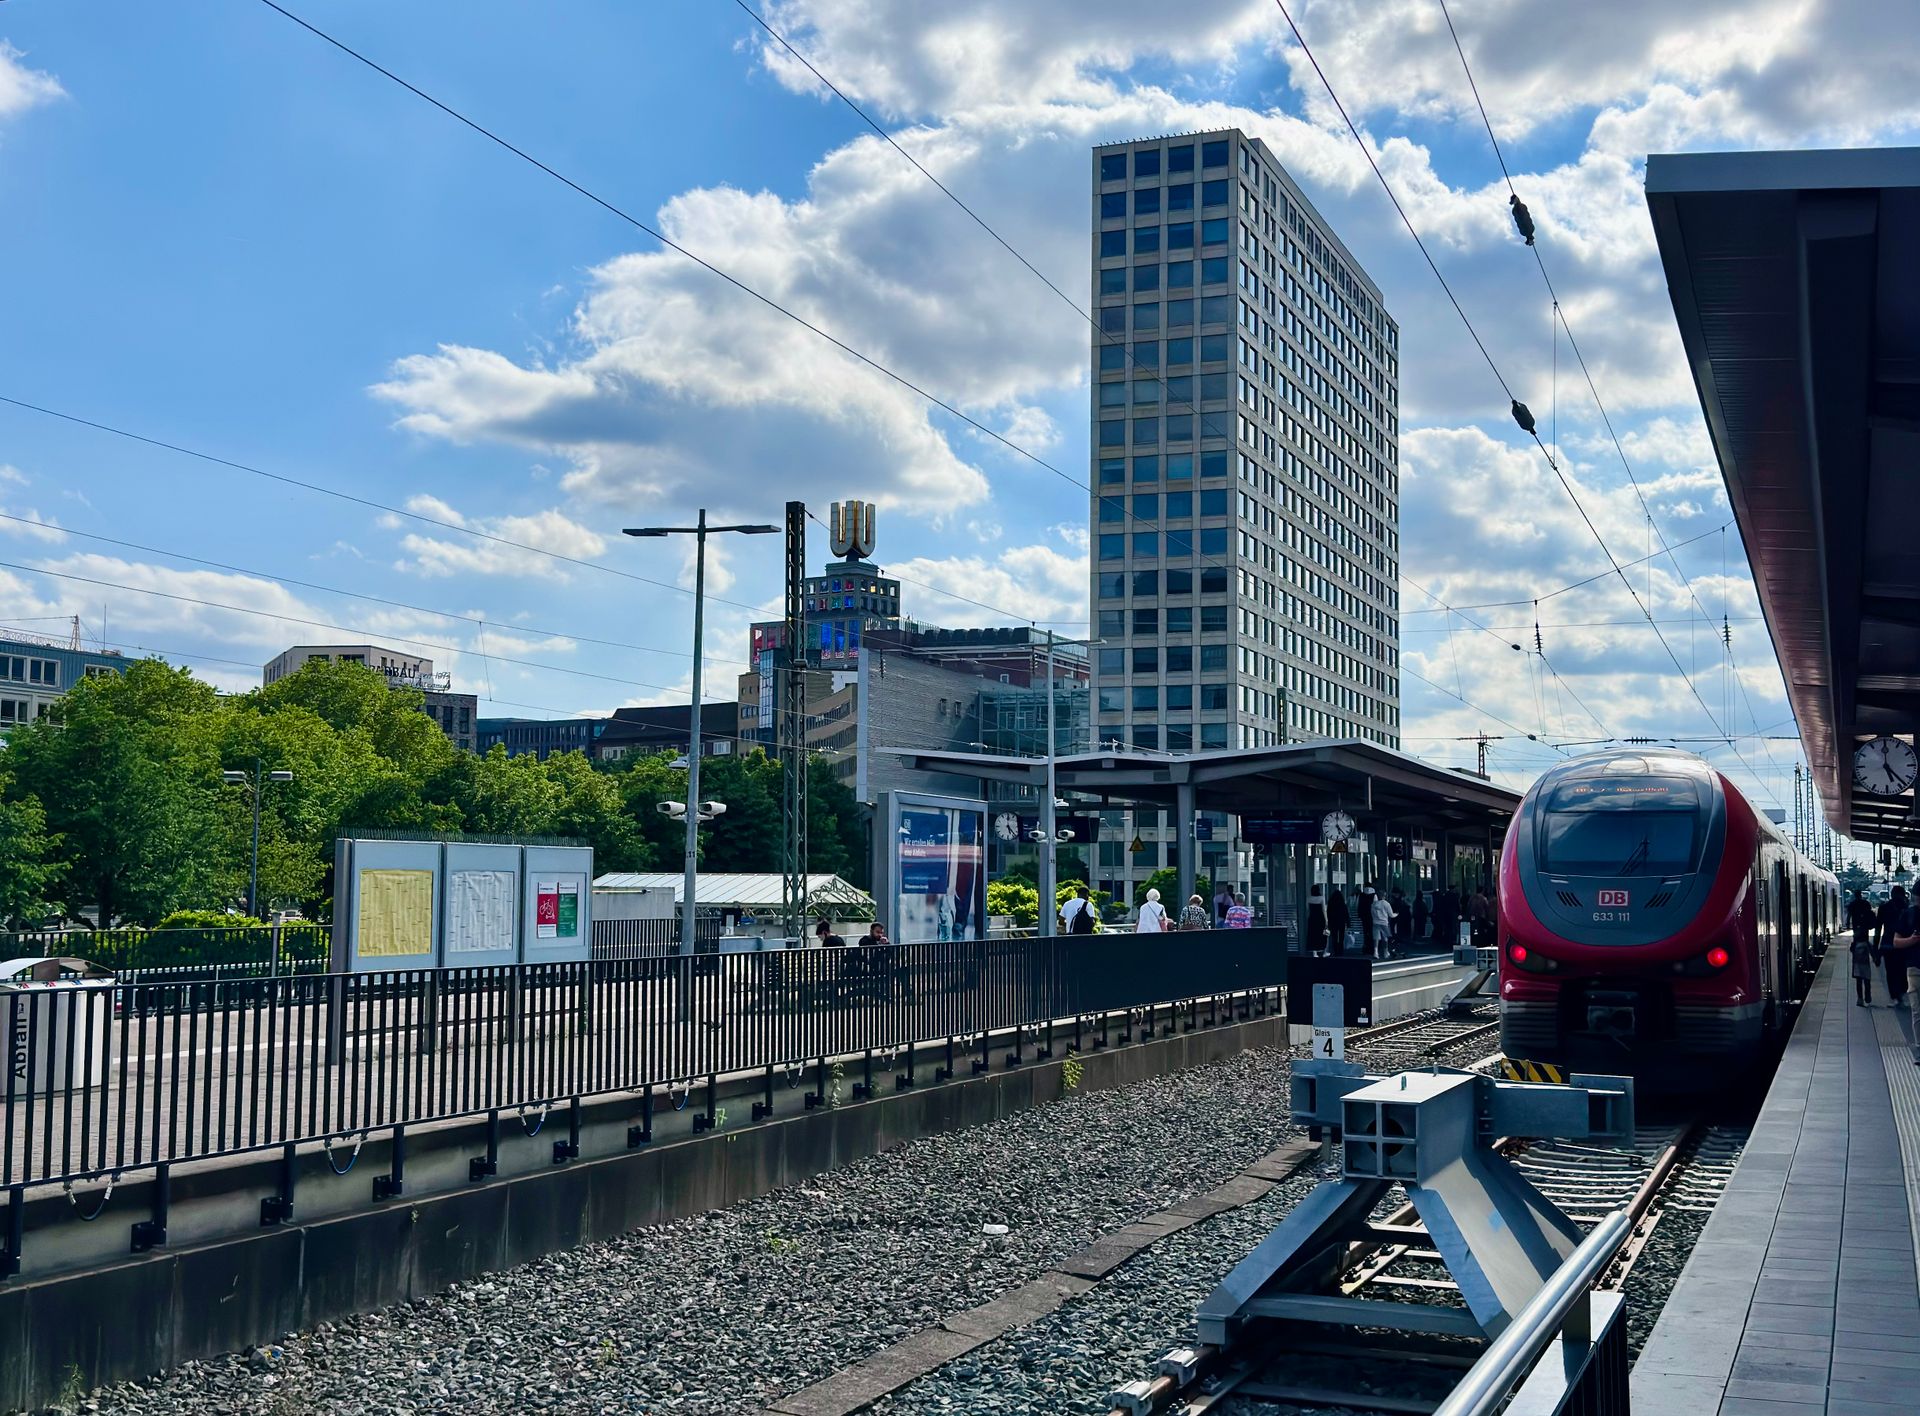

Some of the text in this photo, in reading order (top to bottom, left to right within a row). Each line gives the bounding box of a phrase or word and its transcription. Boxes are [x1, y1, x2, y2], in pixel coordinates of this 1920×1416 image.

[1600, 891, 1628, 906] DB
[1592, 912, 1630, 922] 633 111
[1314, 1029, 1331, 1037] Gleis
[1323, 1037, 1334, 1058] 4
